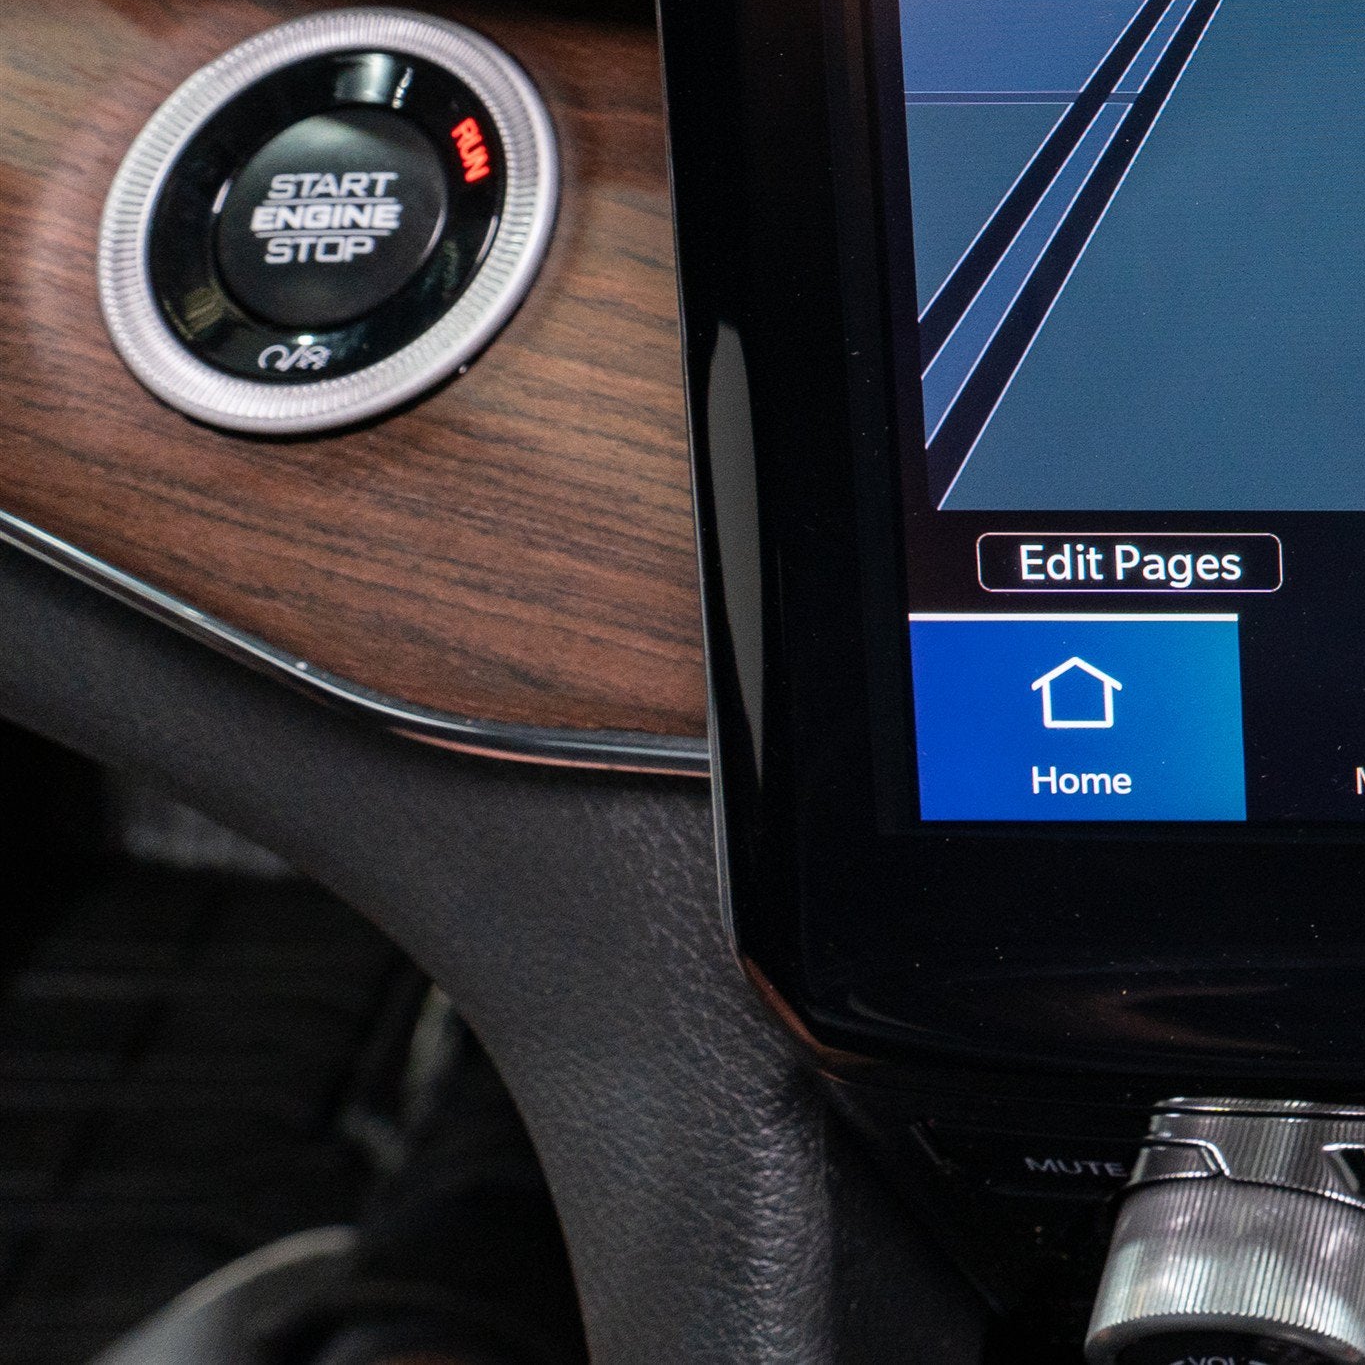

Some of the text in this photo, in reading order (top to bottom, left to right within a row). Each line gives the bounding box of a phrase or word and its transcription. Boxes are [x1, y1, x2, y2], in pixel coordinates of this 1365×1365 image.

[451, 116, 490, 183] RUN
[268, 172, 399, 200] START
[250, 204, 402, 231] ENGINE
[265, 236, 374, 265] STOP
[1019, 544, 1242, 590] Edit Pages
[1032, 766, 1133, 795] Home
[1024, 1156, 1128, 1178] MUTE
